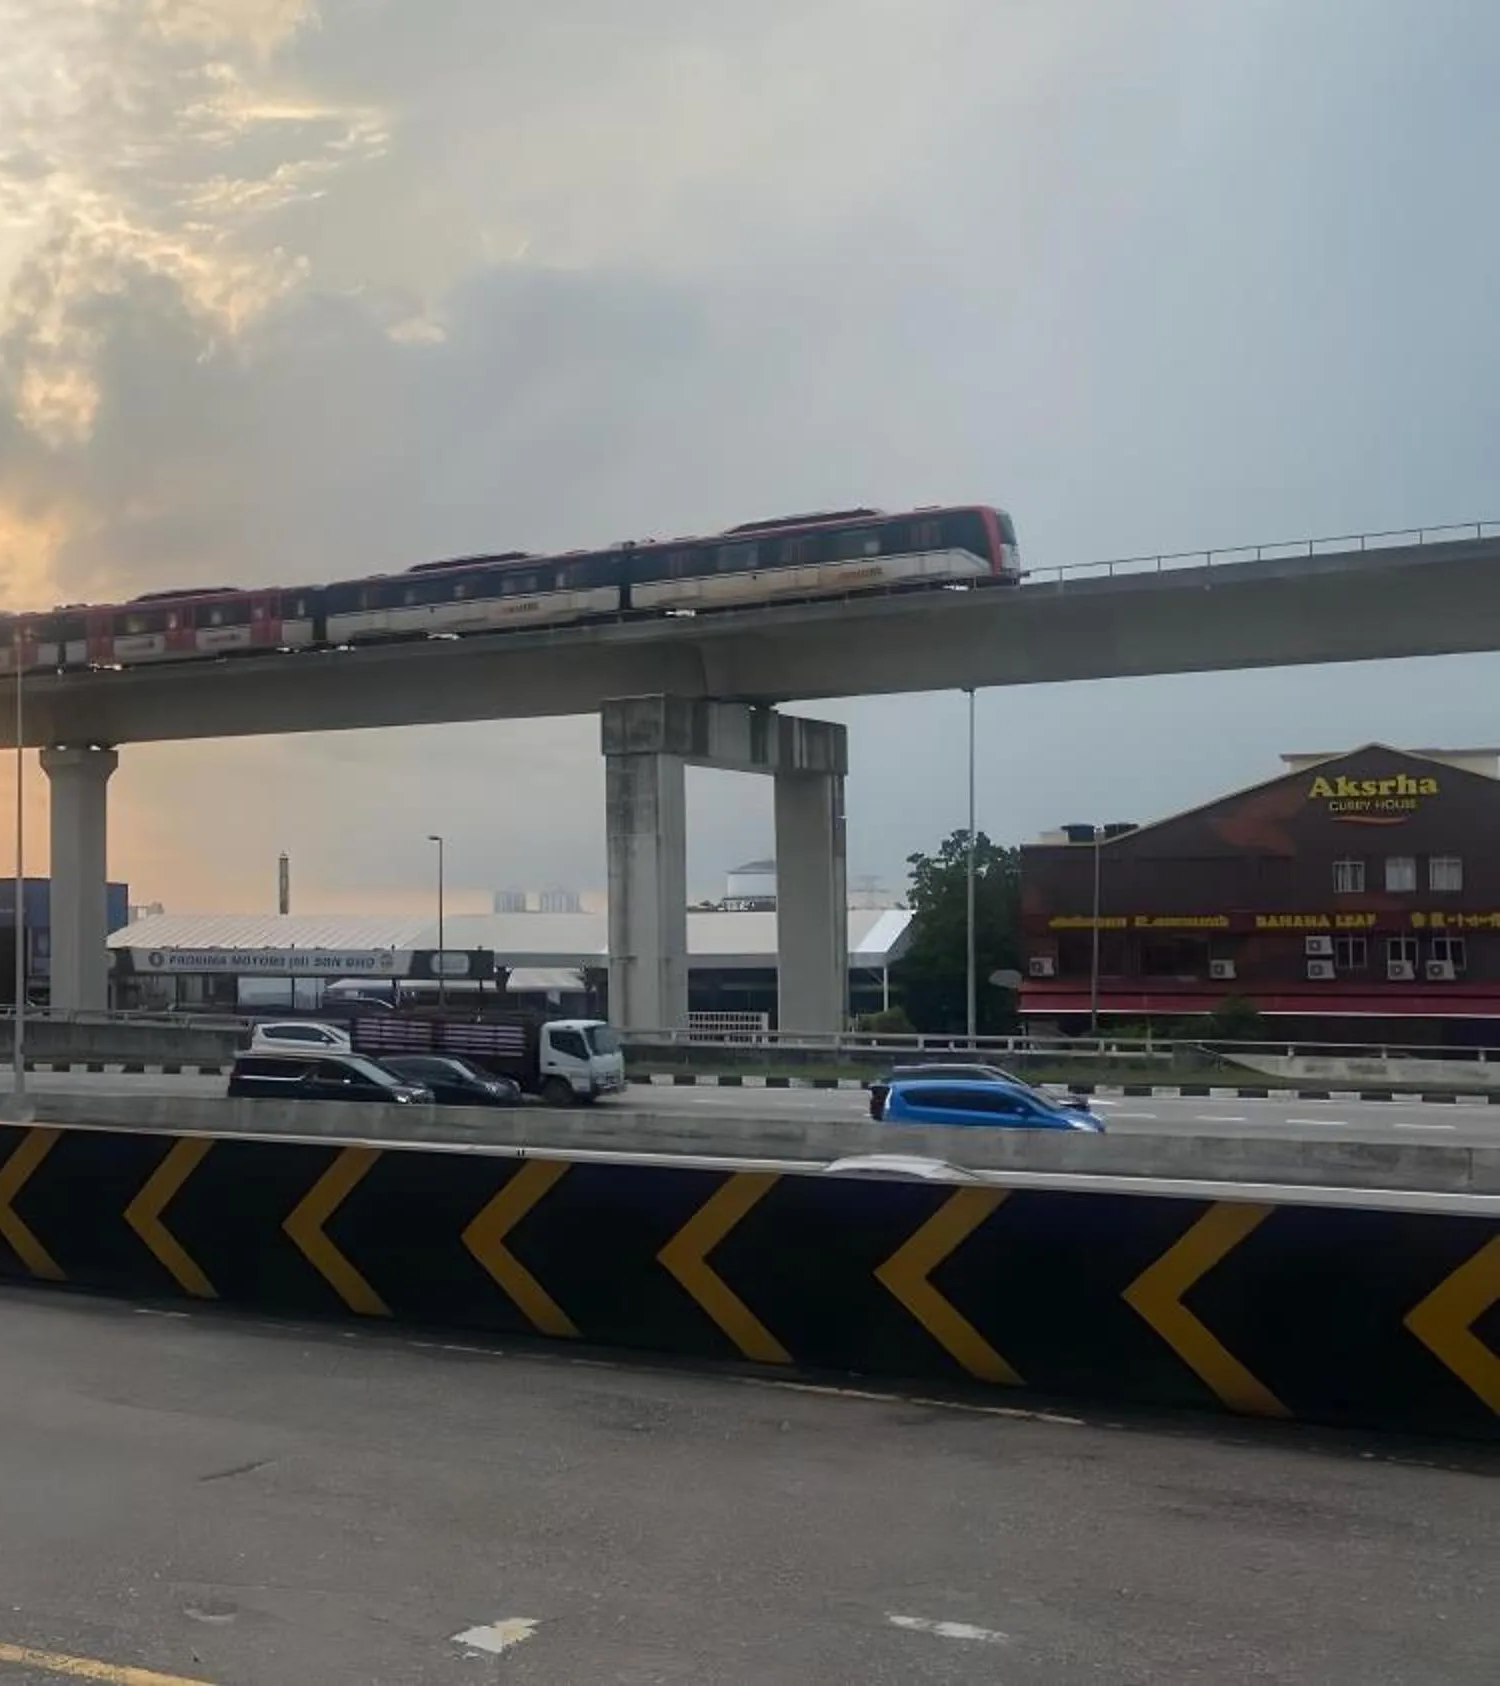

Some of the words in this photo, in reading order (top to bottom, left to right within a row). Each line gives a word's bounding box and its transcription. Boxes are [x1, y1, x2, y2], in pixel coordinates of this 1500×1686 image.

[1308, 773, 1438, 798] Aksrha
[1255, 913, 1331, 928] BANANA
[1335, 912, 1377, 928] LEAF
